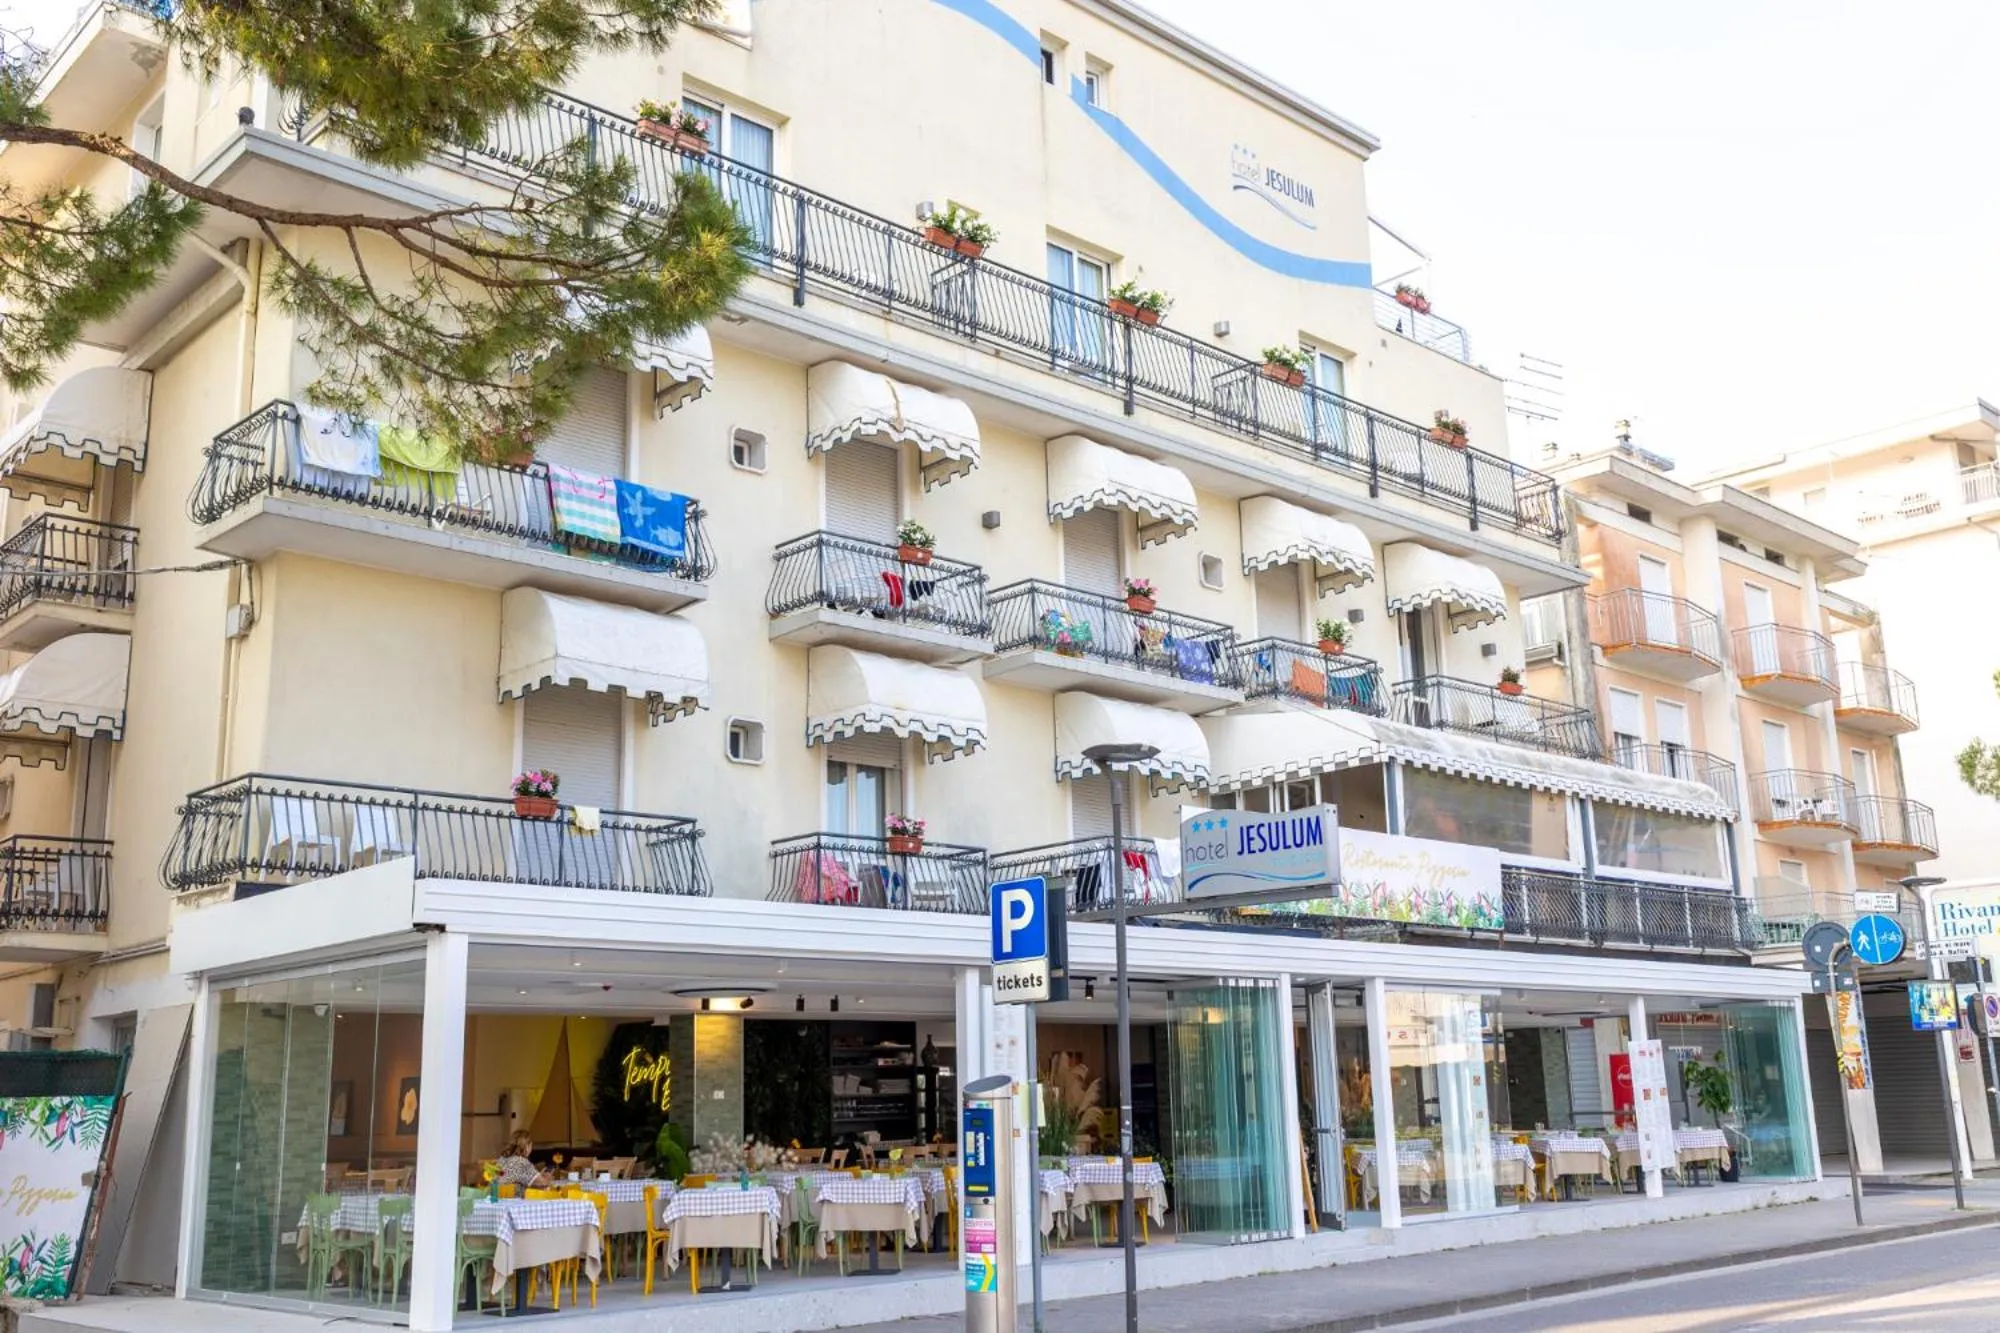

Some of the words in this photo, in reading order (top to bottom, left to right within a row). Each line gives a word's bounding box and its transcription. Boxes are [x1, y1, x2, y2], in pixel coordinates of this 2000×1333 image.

[1265, 167, 1315, 208] JESULUM
[1185, 828, 1229, 864] hotel
[1237, 815, 1323, 856] JESULUM
[1001, 888, 1035, 953] P
[1943, 918, 1992, 937] Hotel
[997, 972, 1043, 991] tickets
